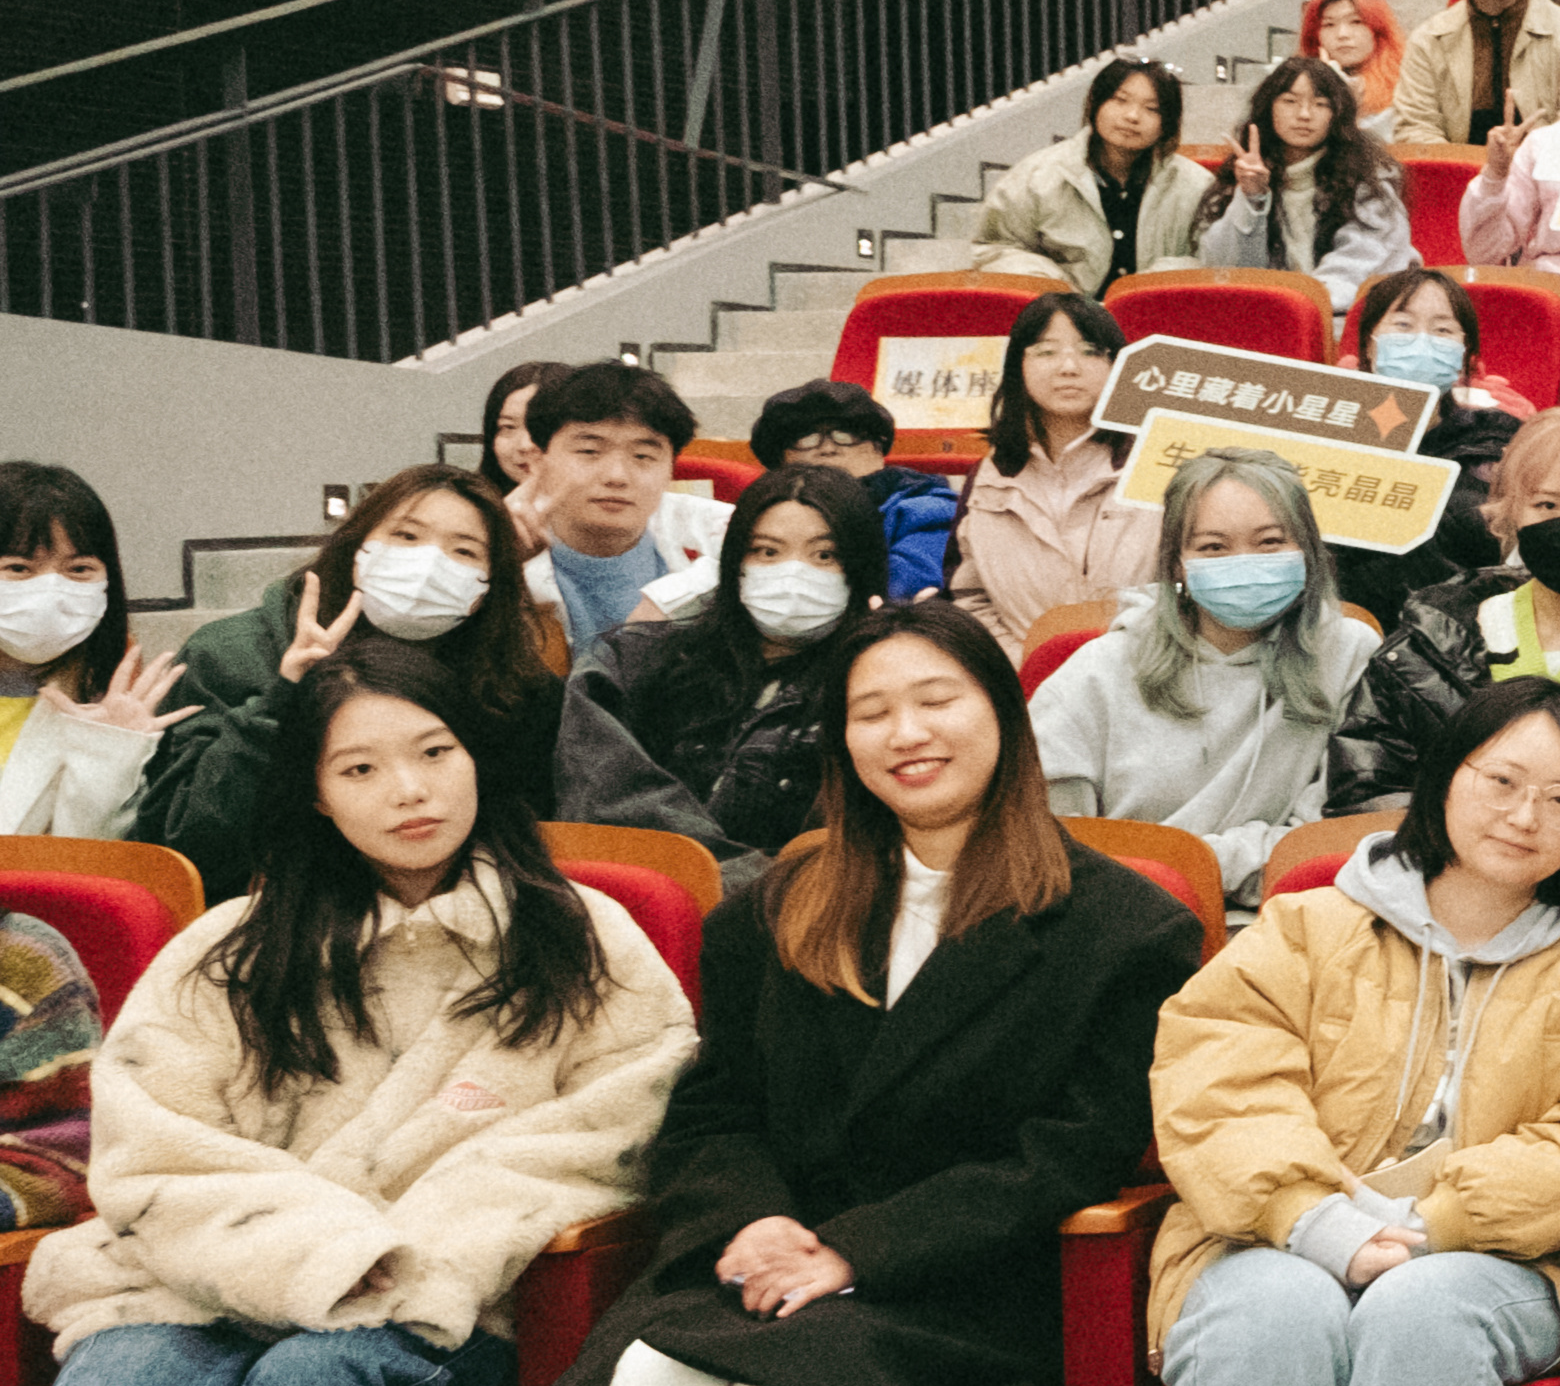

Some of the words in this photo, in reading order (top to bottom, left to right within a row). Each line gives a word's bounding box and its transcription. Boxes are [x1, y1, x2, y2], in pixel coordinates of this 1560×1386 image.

[1131, 365, 1361, 429] 心里藏着小星星
